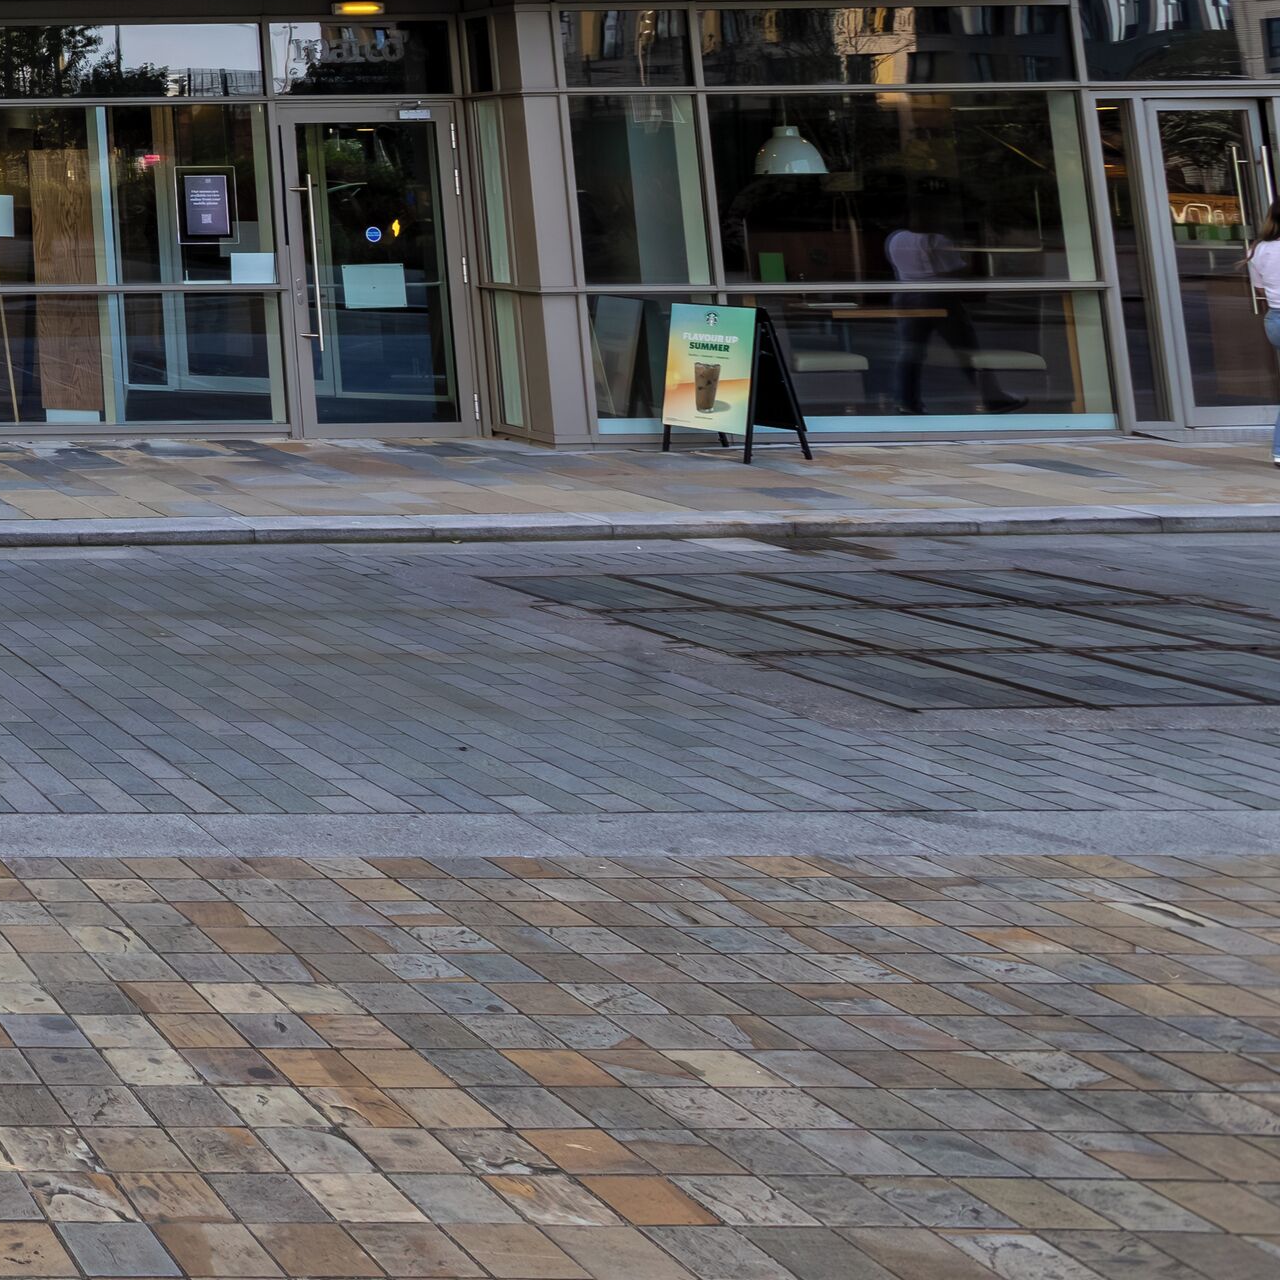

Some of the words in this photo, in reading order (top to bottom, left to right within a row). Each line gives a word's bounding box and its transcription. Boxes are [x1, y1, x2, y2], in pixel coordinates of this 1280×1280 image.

[682, 332, 724, 343] FLAVOUR
[725, 335, 739, 344] UP
[689, 341, 730, 352] SUMMER
